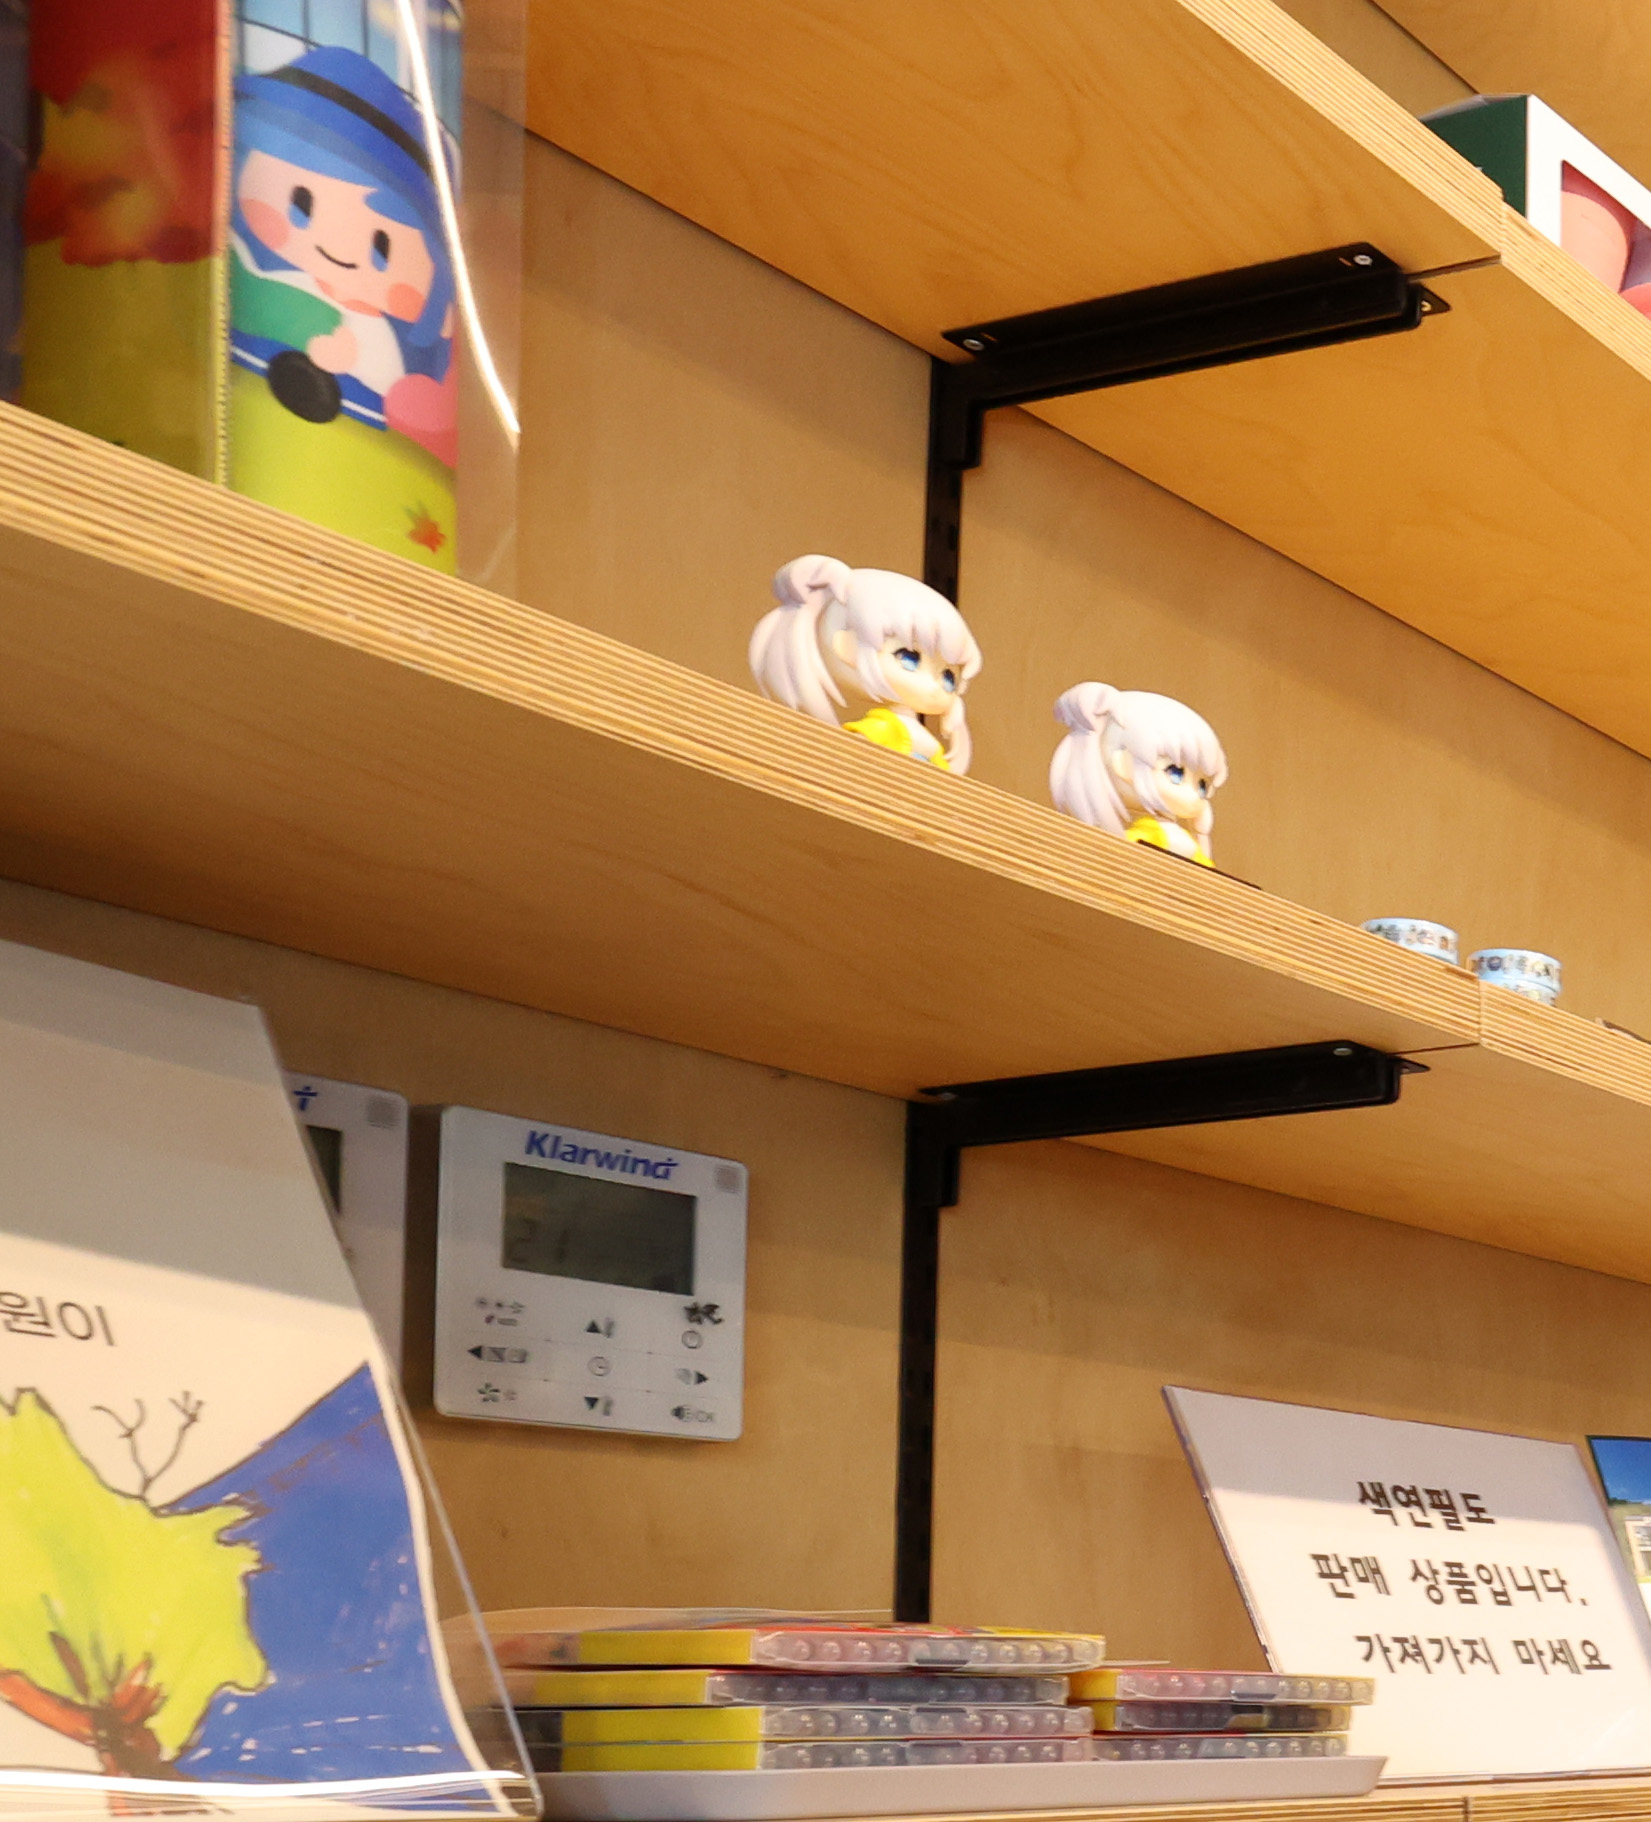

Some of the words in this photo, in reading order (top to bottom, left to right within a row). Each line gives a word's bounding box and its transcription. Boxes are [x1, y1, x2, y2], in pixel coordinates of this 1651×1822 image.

[1357, 1480, 1496, 1532] 색연필도
[1309, 1552, 1391, 1600] 판매
[1409, 1558, 1590, 1607] 상품입니다.
[1354, 1633, 1501, 1675] 가져가지
[1512, 1637, 1613, 1676] 마세요
